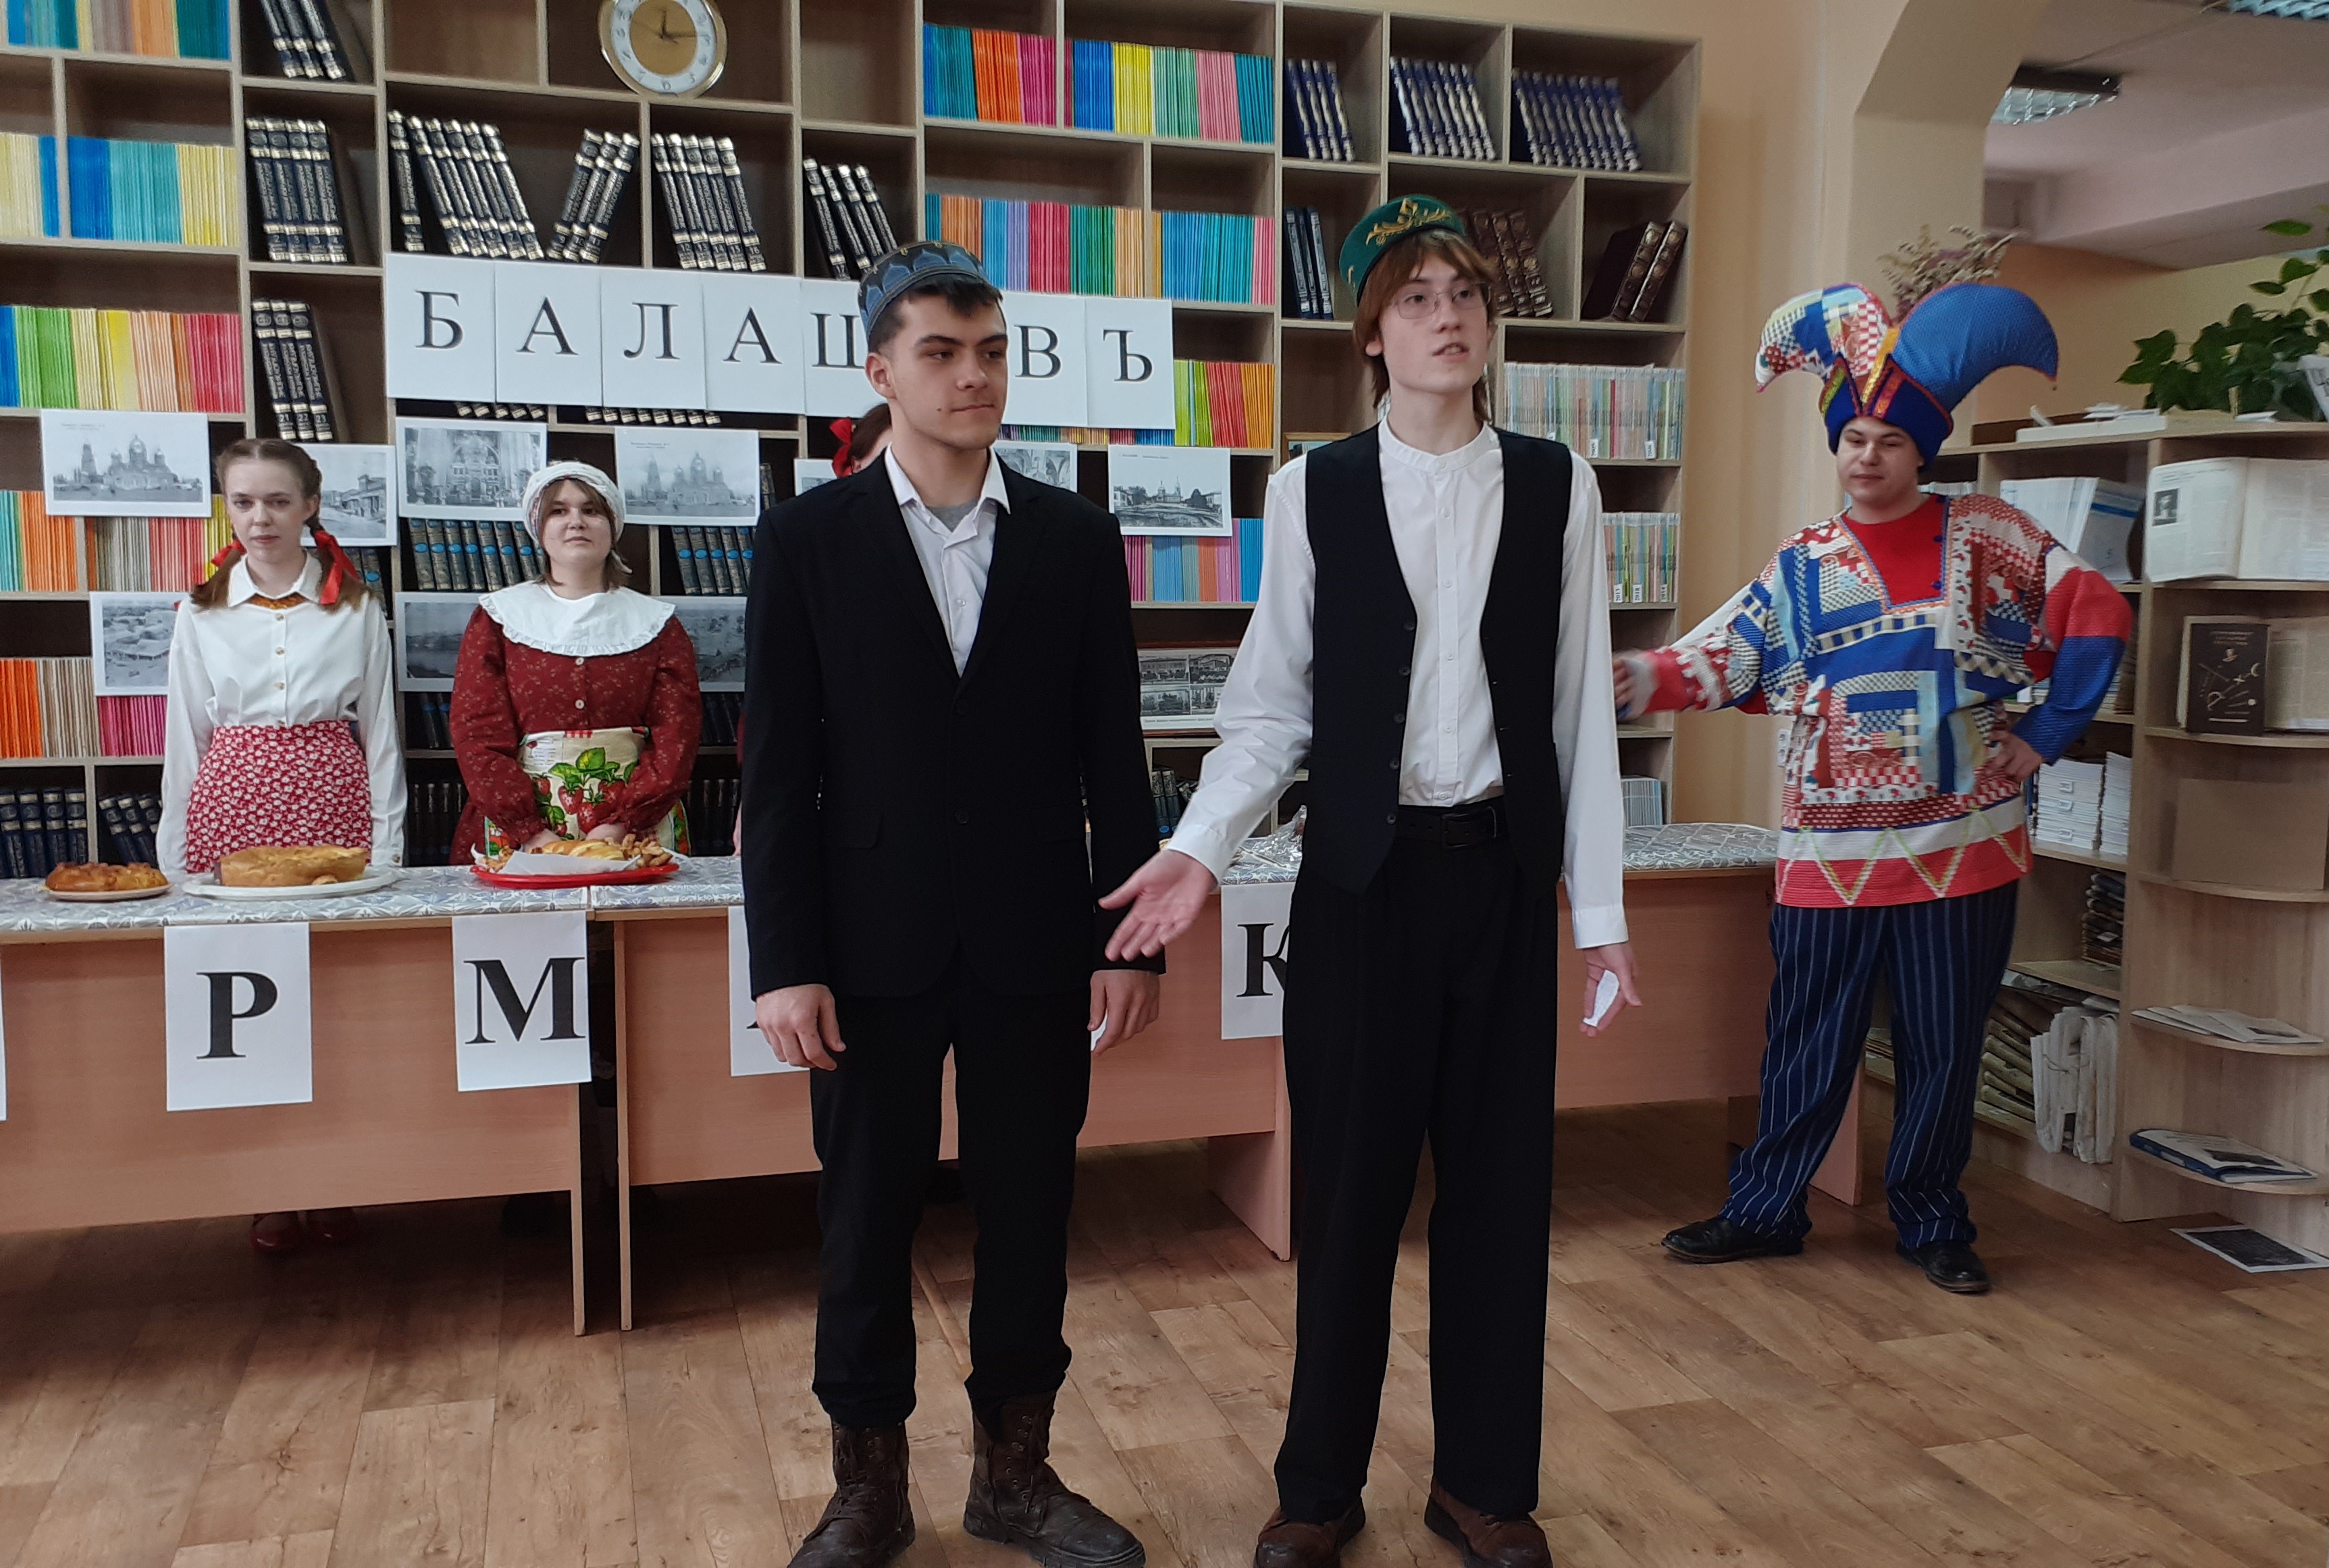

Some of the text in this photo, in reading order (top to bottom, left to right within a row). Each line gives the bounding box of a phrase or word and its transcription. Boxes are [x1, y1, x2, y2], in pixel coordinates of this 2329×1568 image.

[750, 246, 760, 255] 16
[415, 290, 1153, 383] БАЛАШВЪ
[196, 971, 278, 1060] Р
[463, 956, 586, 1045] М
